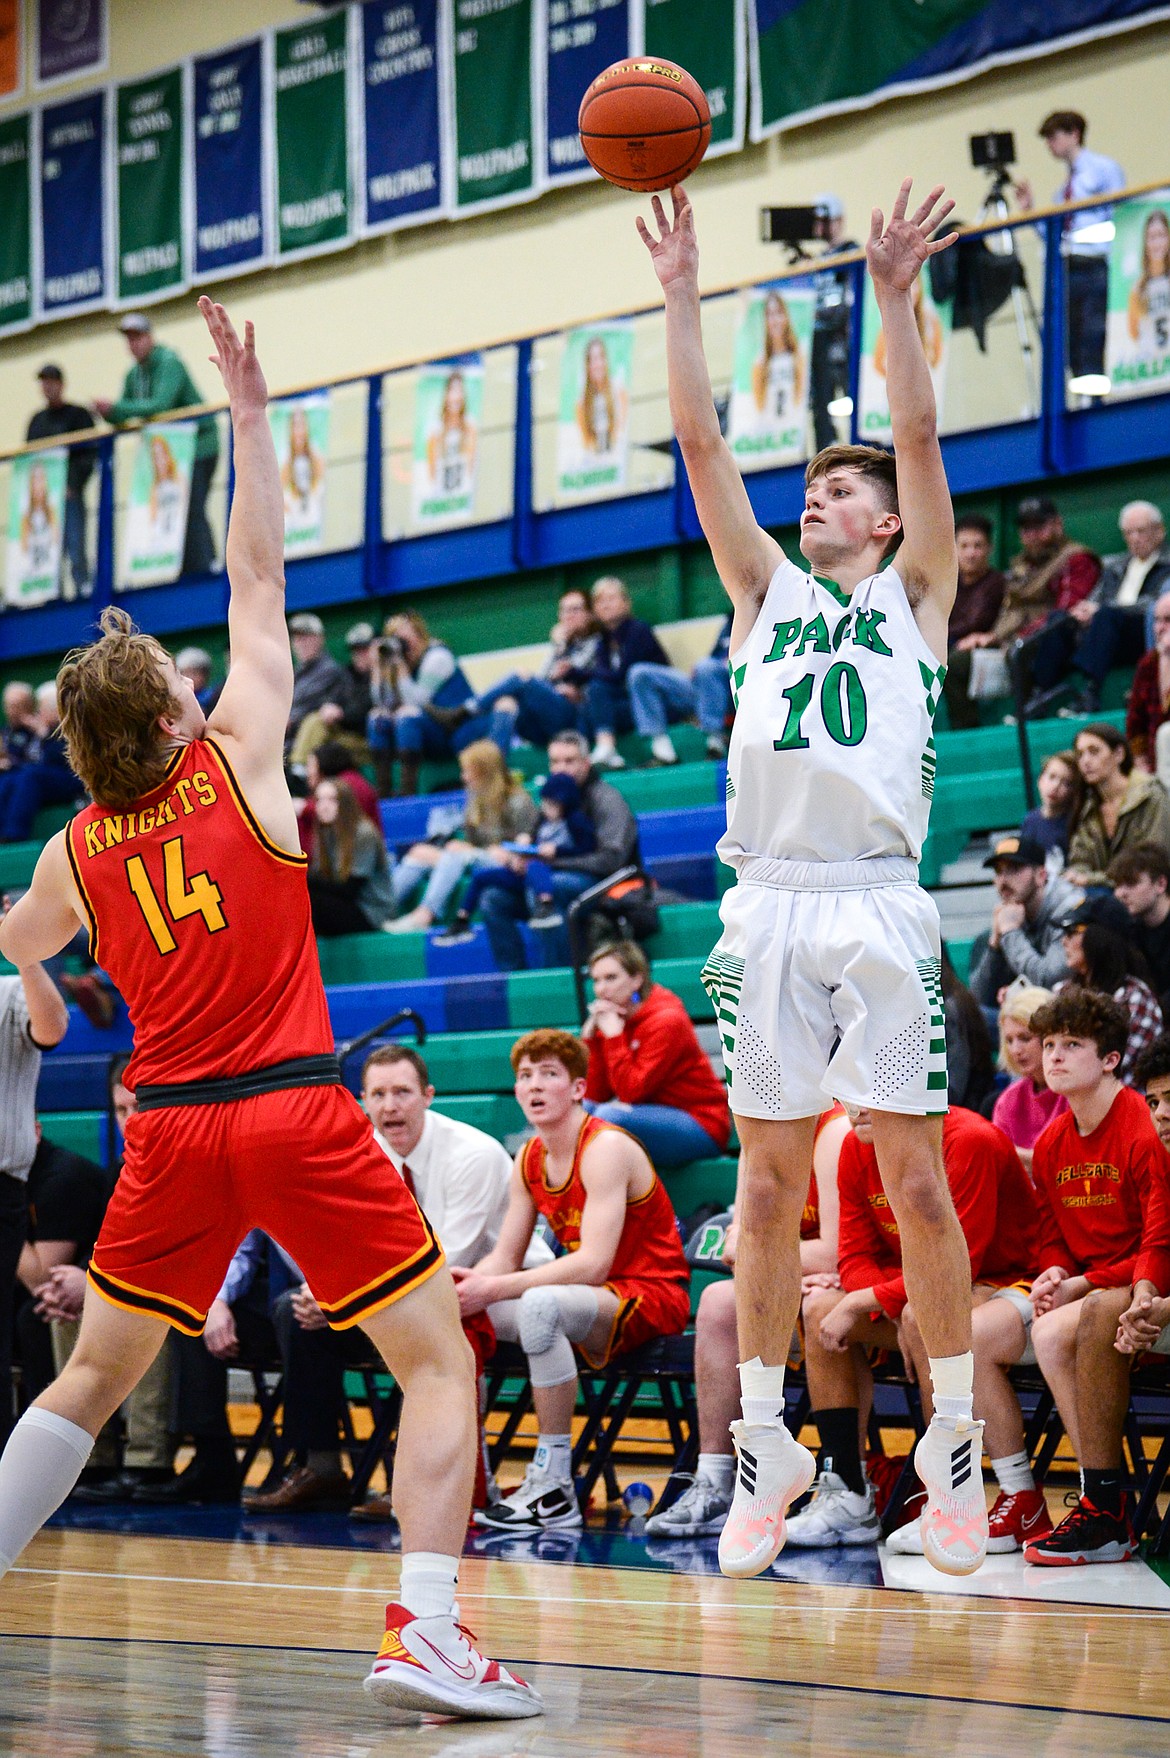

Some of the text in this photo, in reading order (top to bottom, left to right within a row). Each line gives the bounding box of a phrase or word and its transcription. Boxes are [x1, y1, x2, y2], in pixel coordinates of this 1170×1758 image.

[762, 607, 893, 664] PACK
[773, 661, 868, 751] 10
[84, 771, 218, 858] KNIGHTS
[124, 835, 229, 957] 14
